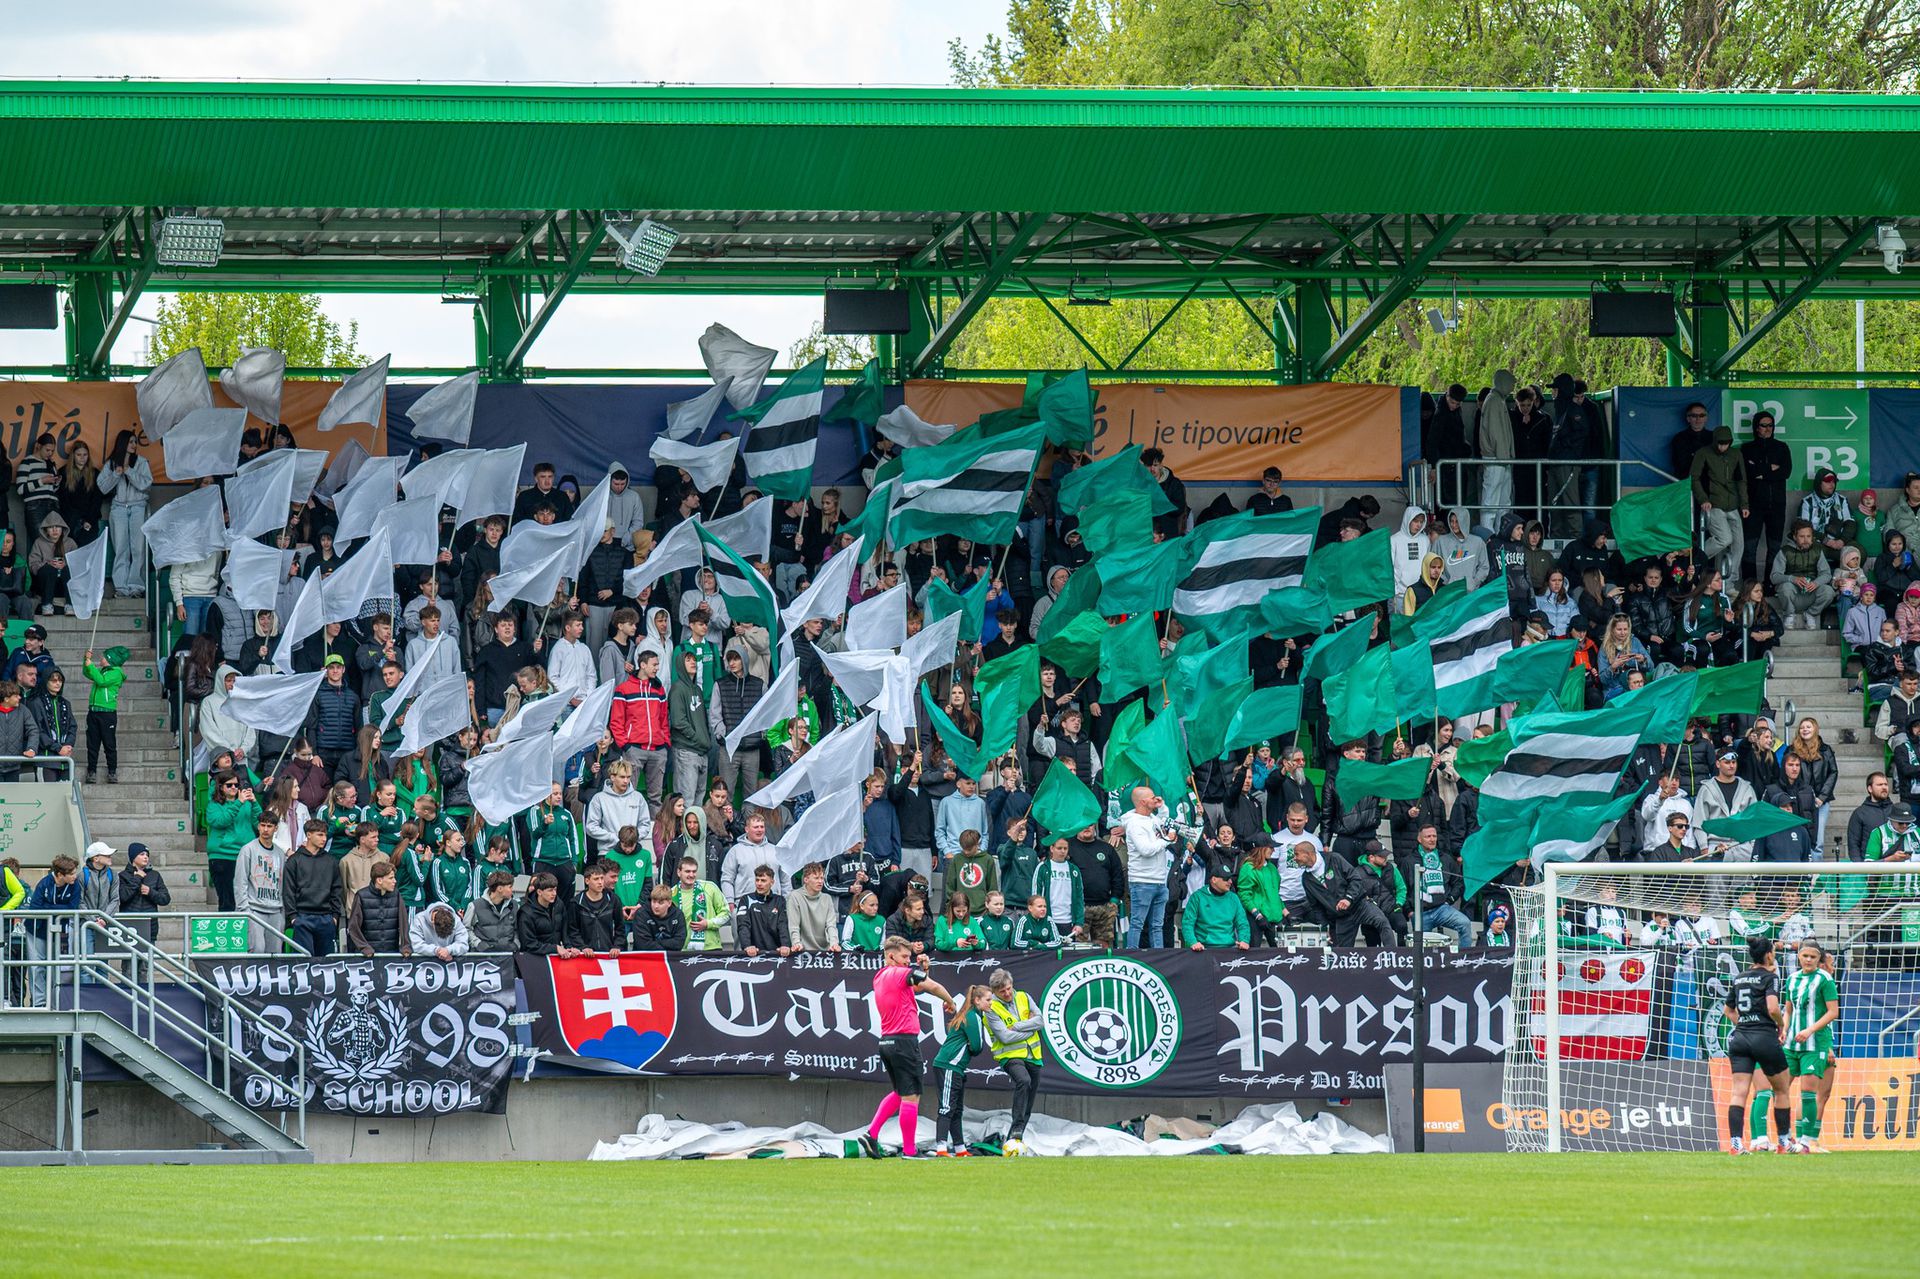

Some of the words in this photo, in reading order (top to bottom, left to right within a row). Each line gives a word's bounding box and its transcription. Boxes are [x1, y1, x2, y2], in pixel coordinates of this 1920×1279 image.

[1733, 400, 1786, 434] B2
[0, 401, 81, 460] iké
[1152, 419, 1176, 449] je
[1182, 419, 1303, 451] tipovanie
[1807, 446, 1859, 480] B3
[133, 618, 142, 629] 9
[145, 668, 153, 679] 8
[157, 717, 165, 729] 7
[167, 769, 175, 781] 6
[177, 820, 185, 832] 5
[188, 872, 197, 884] 4
[792, 953, 835, 970] Náš
[1318, 952, 1368, 971] Naše
[1373, 951, 1434, 971] Meso
[212, 960, 376, 997] WHITE
[384, 961, 502, 997] BOYS
[1047, 980, 1072, 1048] ULTRAS
[1069, 963, 1145, 983] TATRAN
[1738, 988, 1752, 1012] 5
[229, 1004, 296, 1063] 18
[421, 1002, 509, 1068] 98
[784, 1050, 858, 1072] Semper
[1094, 1065, 1142, 1084] 1898
[1310, 1071, 1341, 1090] Do
[244, 1074, 317, 1108] OLD
[323, 1079, 482, 1114] SCHOOL
[1423, 1120, 1460, 1131] range
[1619, 1102, 1651, 1134] je
[1655, 1102, 1691, 1127] tu
